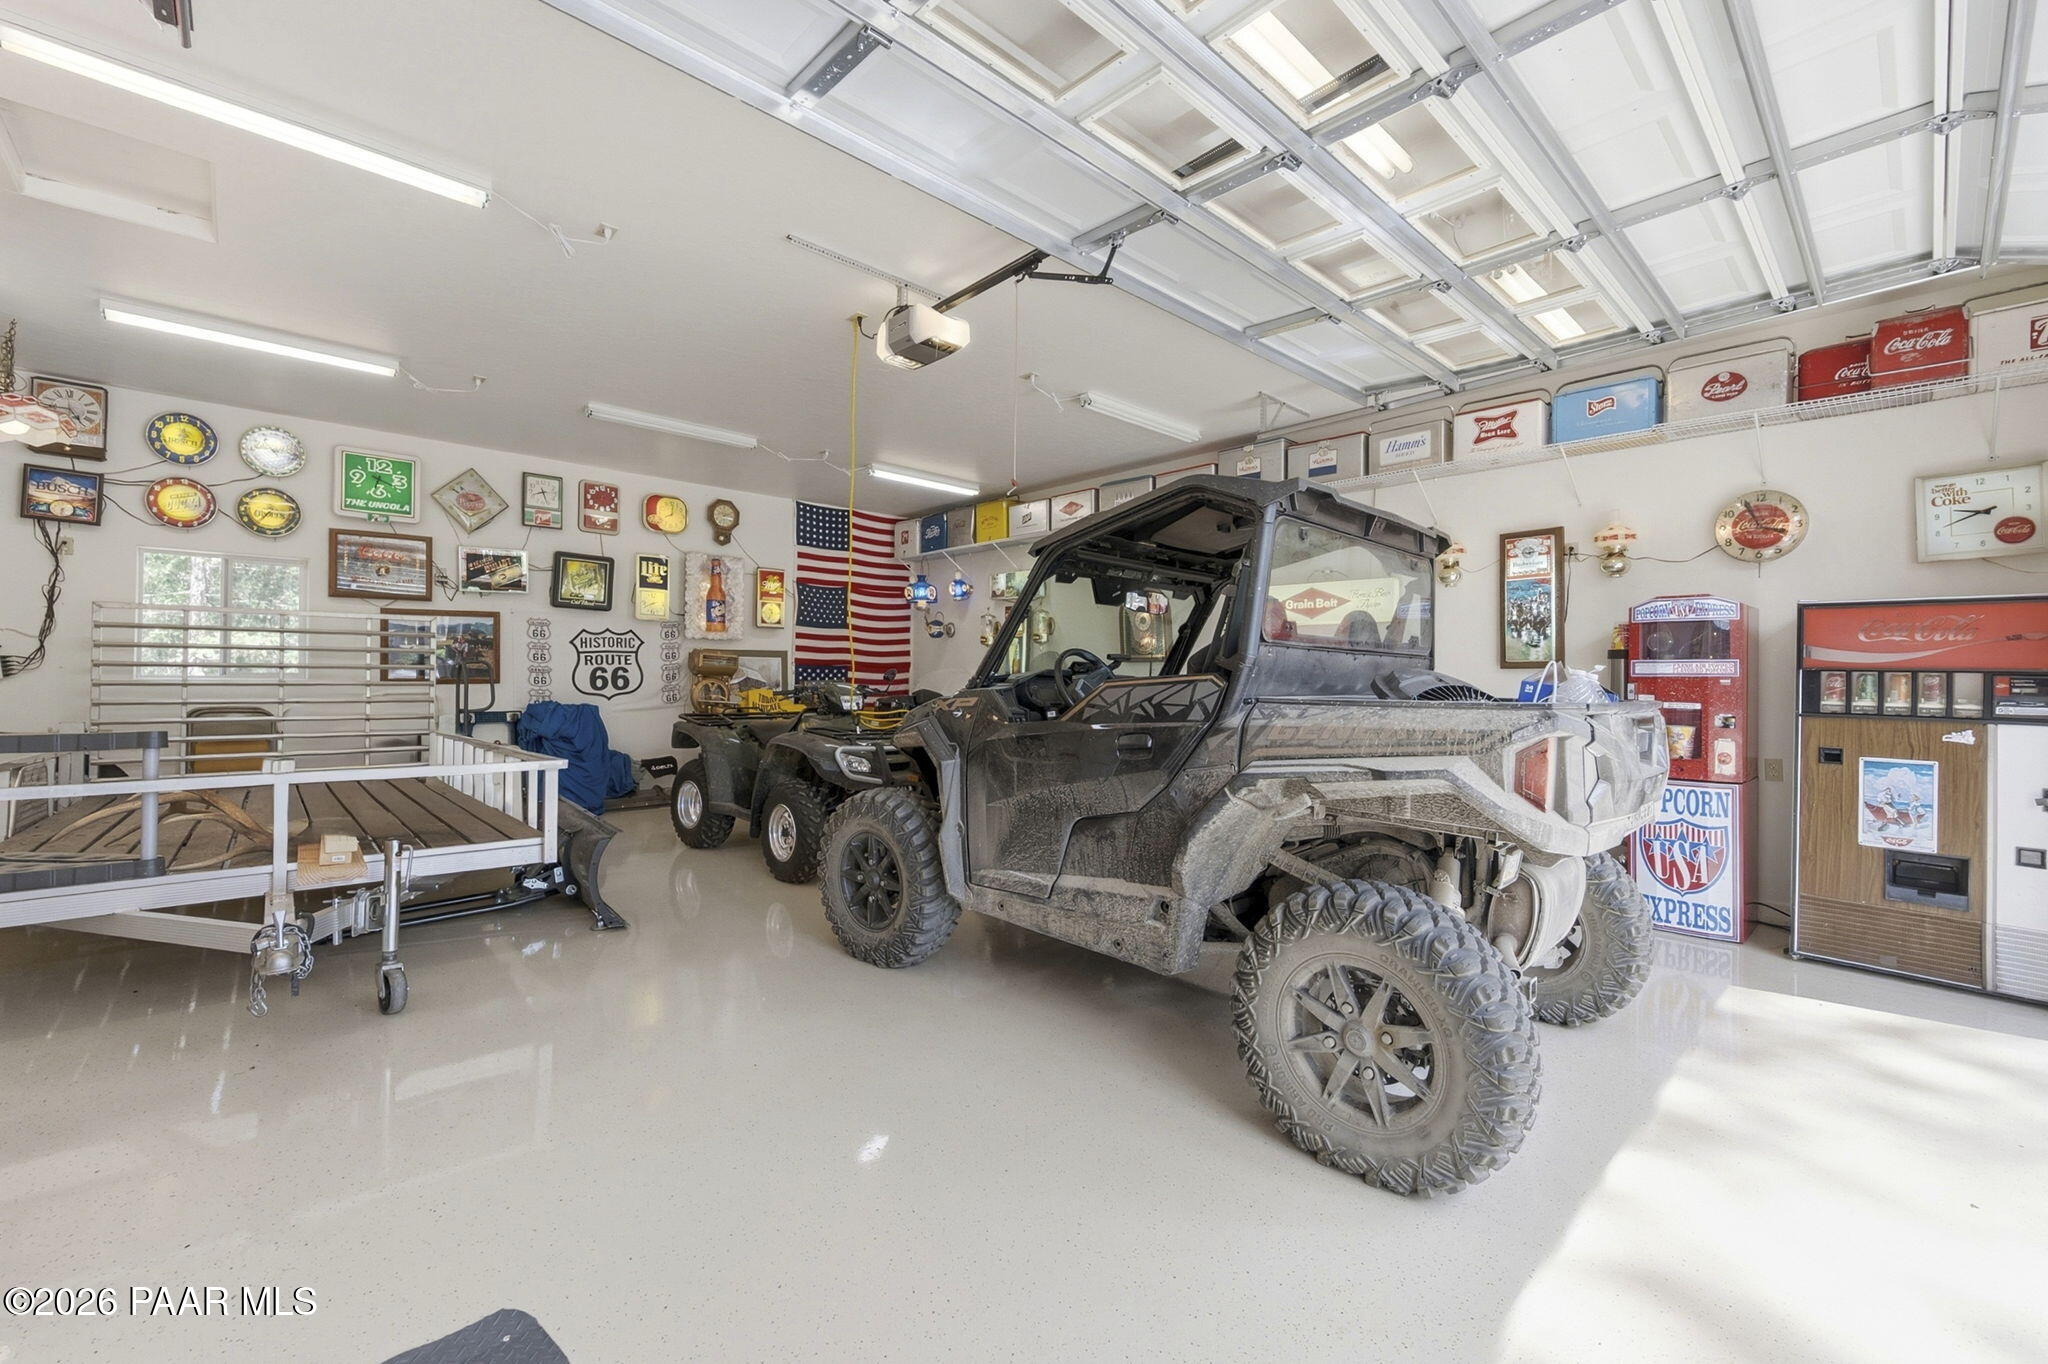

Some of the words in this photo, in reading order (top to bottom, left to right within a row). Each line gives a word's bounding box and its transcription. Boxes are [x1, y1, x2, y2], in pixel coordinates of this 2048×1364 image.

[1884, 328, 1954, 355] Coca-Cola
[366, 458, 393, 475] 12
[349, 469, 366, 484] 9
[392, 474, 408, 489] 3
[35, 481, 89, 497] BUSCH
[370, 484, 387, 499] 6
[345, 498, 367, 507] THE
[1756, 493, 1767, 502] 12
[1930, 495, 1971, 507] Coke
[1791, 504, 1798, 513] 2
[2026, 503, 2032, 511] 3
[1722, 510, 1735, 518] 10
[1724, 538, 1732, 547] 8
[1738, 547, 1745, 556] 7
[1755, 550, 1763, 559] 6
[641, 561, 668, 576] Lite
[1285, 599, 1315, 610] Grain
[1315, 598, 1338, 609] Belt
[1857, 605, 1985, 642] Coca-Cola
[532, 629, 546, 638] 66
[664, 630, 676, 639] 66
[580, 636, 636, 649] HISTORIC
[533, 653, 546, 661] 66
[584, 654, 632, 666] ROUTE
[665, 651, 677, 660] 66
[533, 676, 547, 685] 66
[589, 666, 630, 691] 66
[665, 673, 677, 681] 66
[666, 693, 678, 702] 66
[1661, 788, 1730, 818] PCORN
[1652, 838, 1709, 890] USA
[1643, 894, 1731, 932] XPRESS
